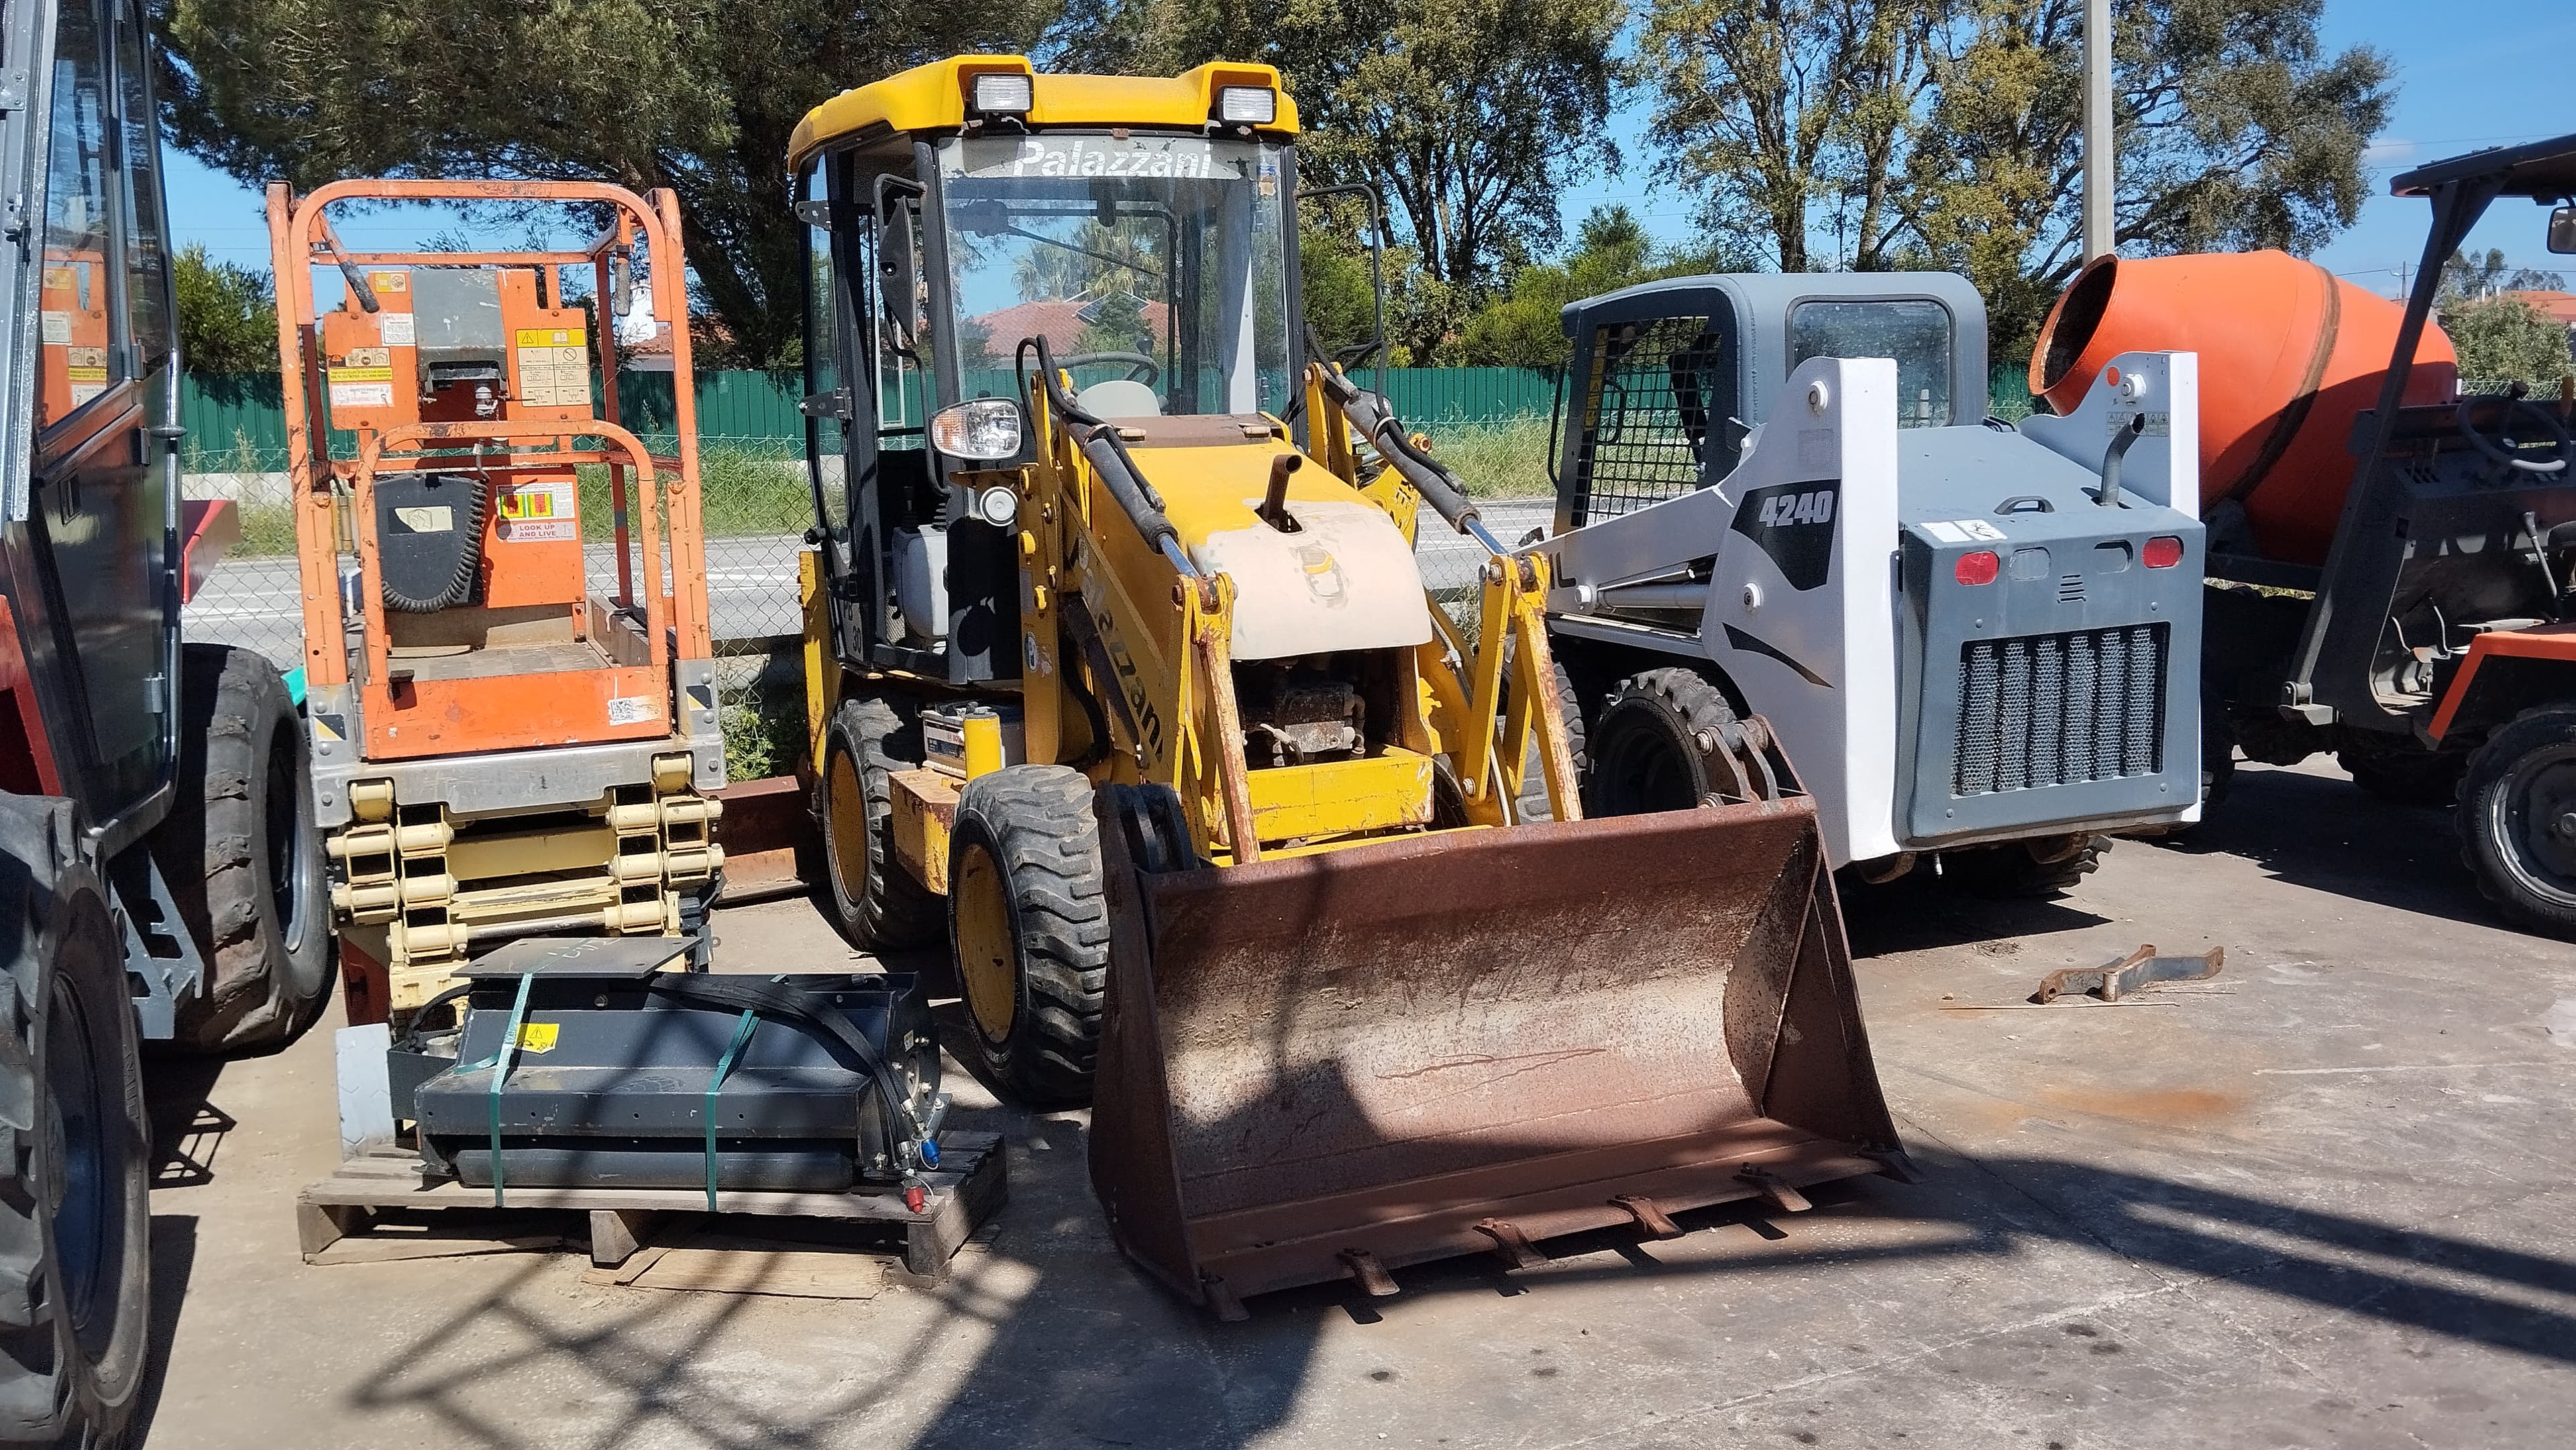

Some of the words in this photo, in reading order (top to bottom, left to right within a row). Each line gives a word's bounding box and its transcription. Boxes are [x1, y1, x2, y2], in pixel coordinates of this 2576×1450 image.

[1013, 140, 1212, 178] Palazzani
[1759, 490, 1833, 527] 4240
[853, 625, 861, 654] 30
